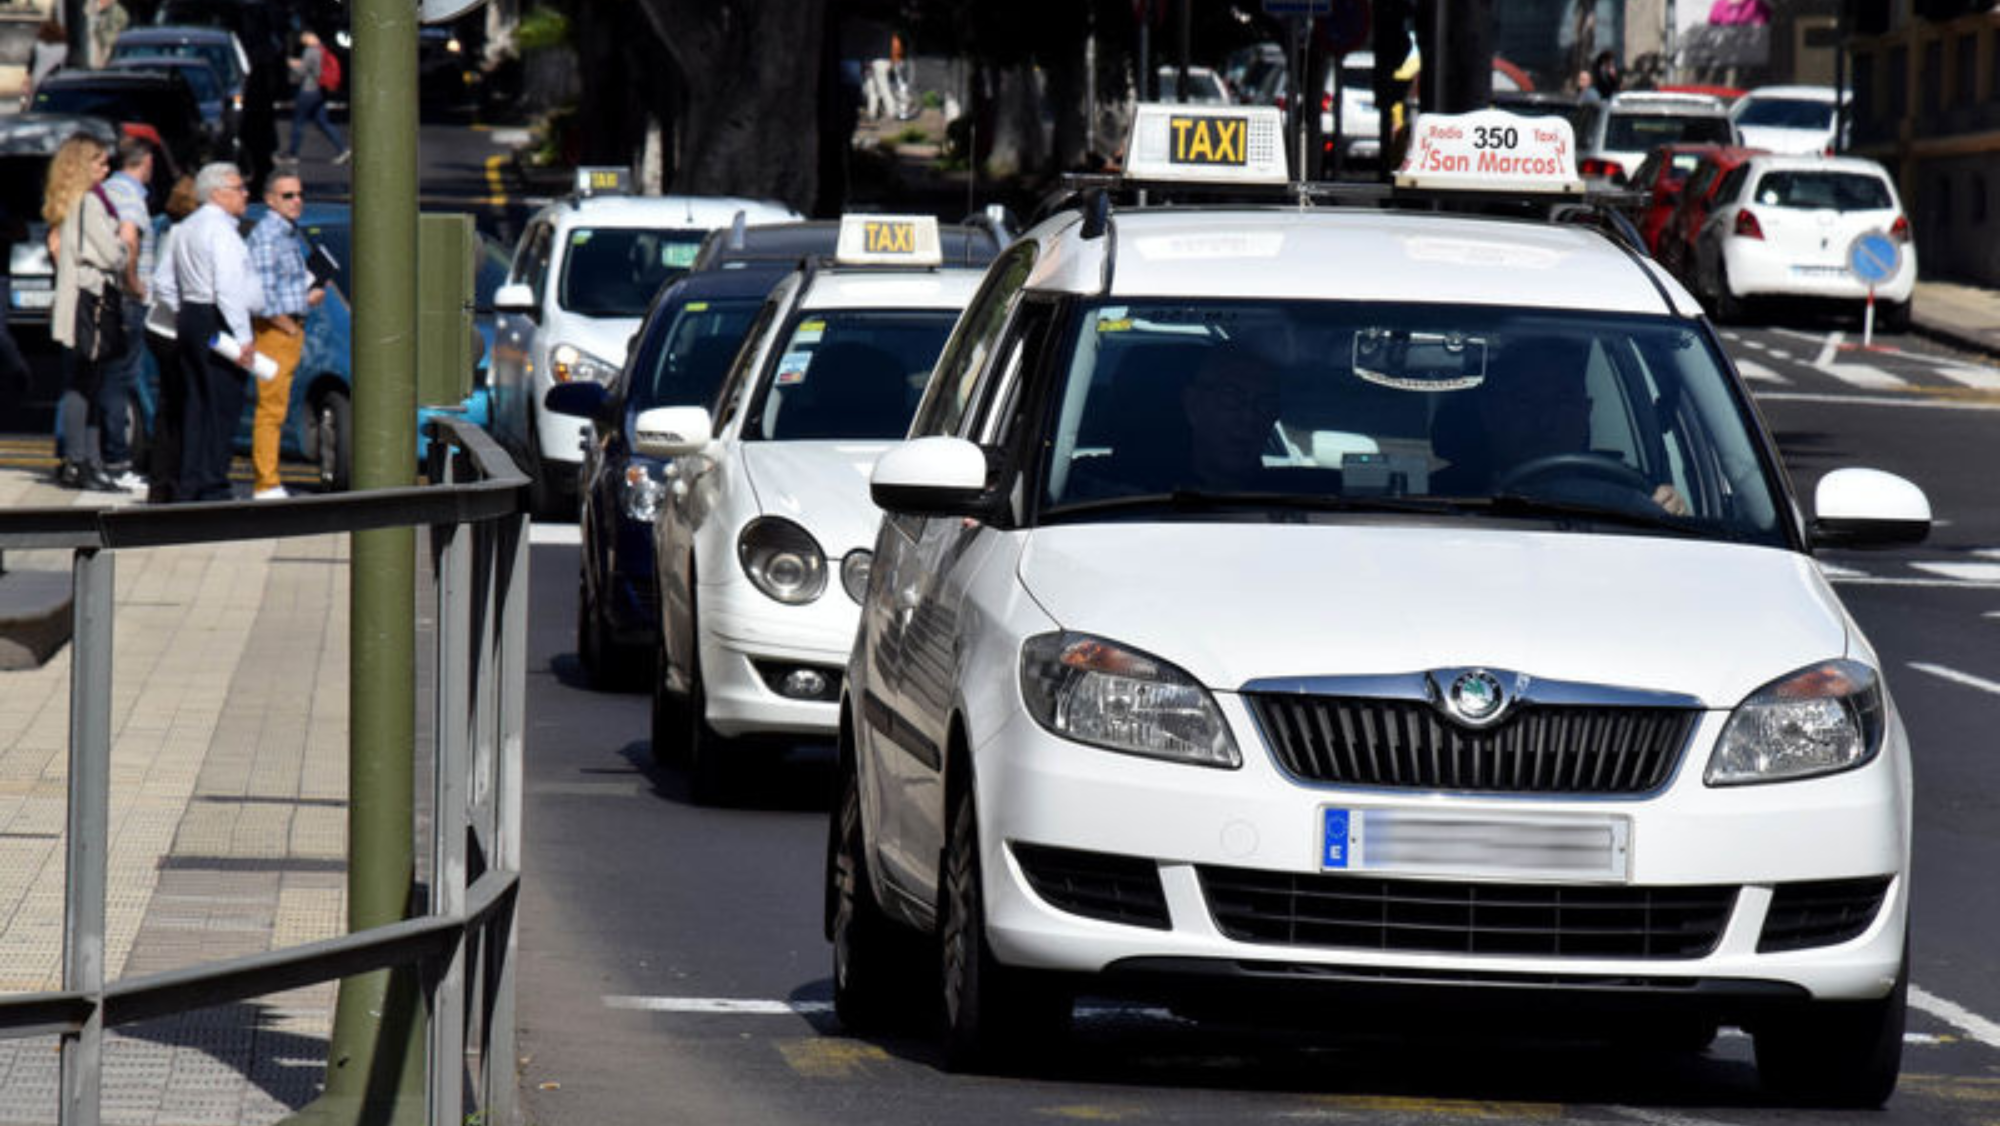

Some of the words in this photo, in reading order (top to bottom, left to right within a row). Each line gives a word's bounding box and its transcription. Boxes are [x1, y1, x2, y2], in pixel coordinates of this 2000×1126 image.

[1171, 118, 1246, 163] TAXI
[1429, 126, 1463, 139] Radio
[1473, 126, 1518, 149] 350
[1533, 129, 1558, 142] Taxi
[1429, 150, 1469, 171] San
[1477, 151, 1556, 174] Marcos
[592, 172, 618, 188] TAXI
[864, 222, 915, 253] TAXI
[1330, 845, 1342, 860] E
